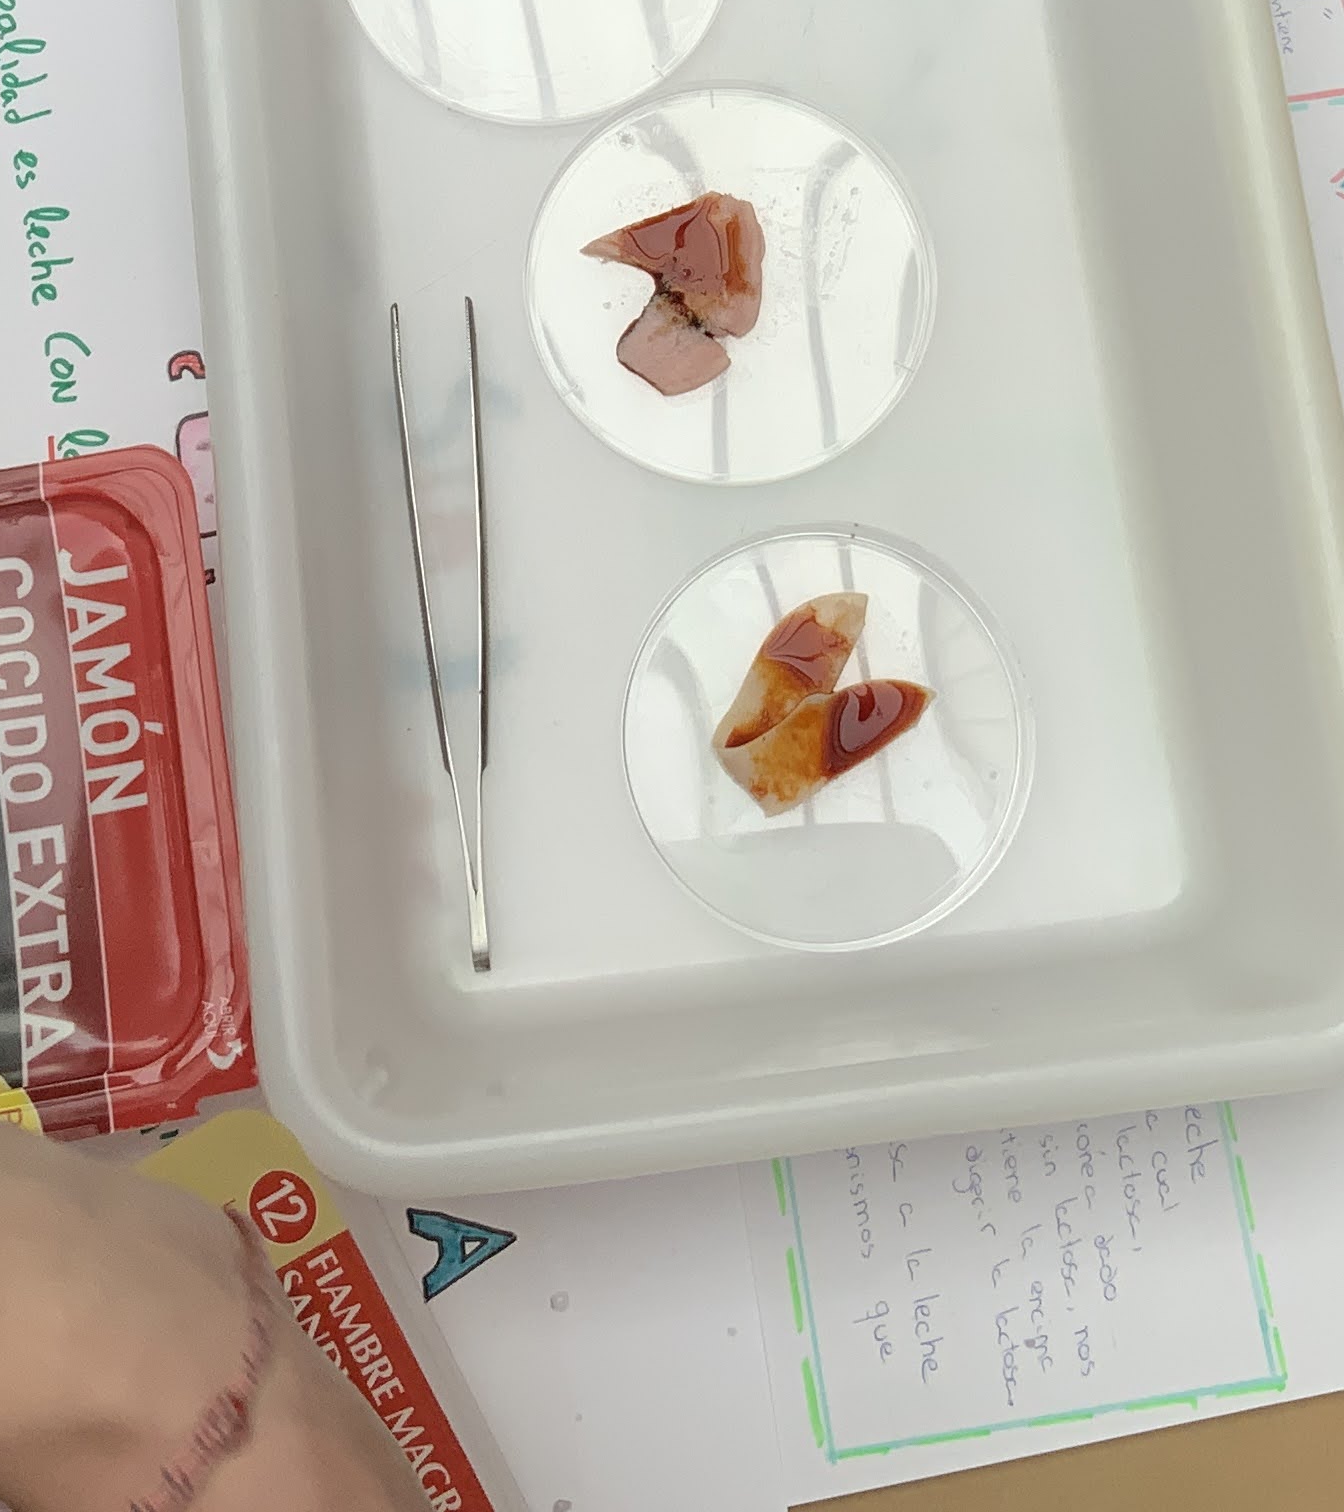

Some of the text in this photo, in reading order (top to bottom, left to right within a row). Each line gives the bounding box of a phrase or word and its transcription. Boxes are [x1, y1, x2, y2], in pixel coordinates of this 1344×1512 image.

[12, 149, 39, 190] es
[23, 205, 73, 306] leche
[6, 823, 77, 1074] EXTRA
[999, 1127, 1022, 1204] tiene
[1183, 1103, 1220, 1185] eche
[256, 1178, 307, 1238] 12
[306, 1249, 405, 1406] FIAMBRE
[853, 1300, 893, 1364] que
[913, 1293, 945, 1385] leche
[1073, 1324, 1096, 1377] nos
